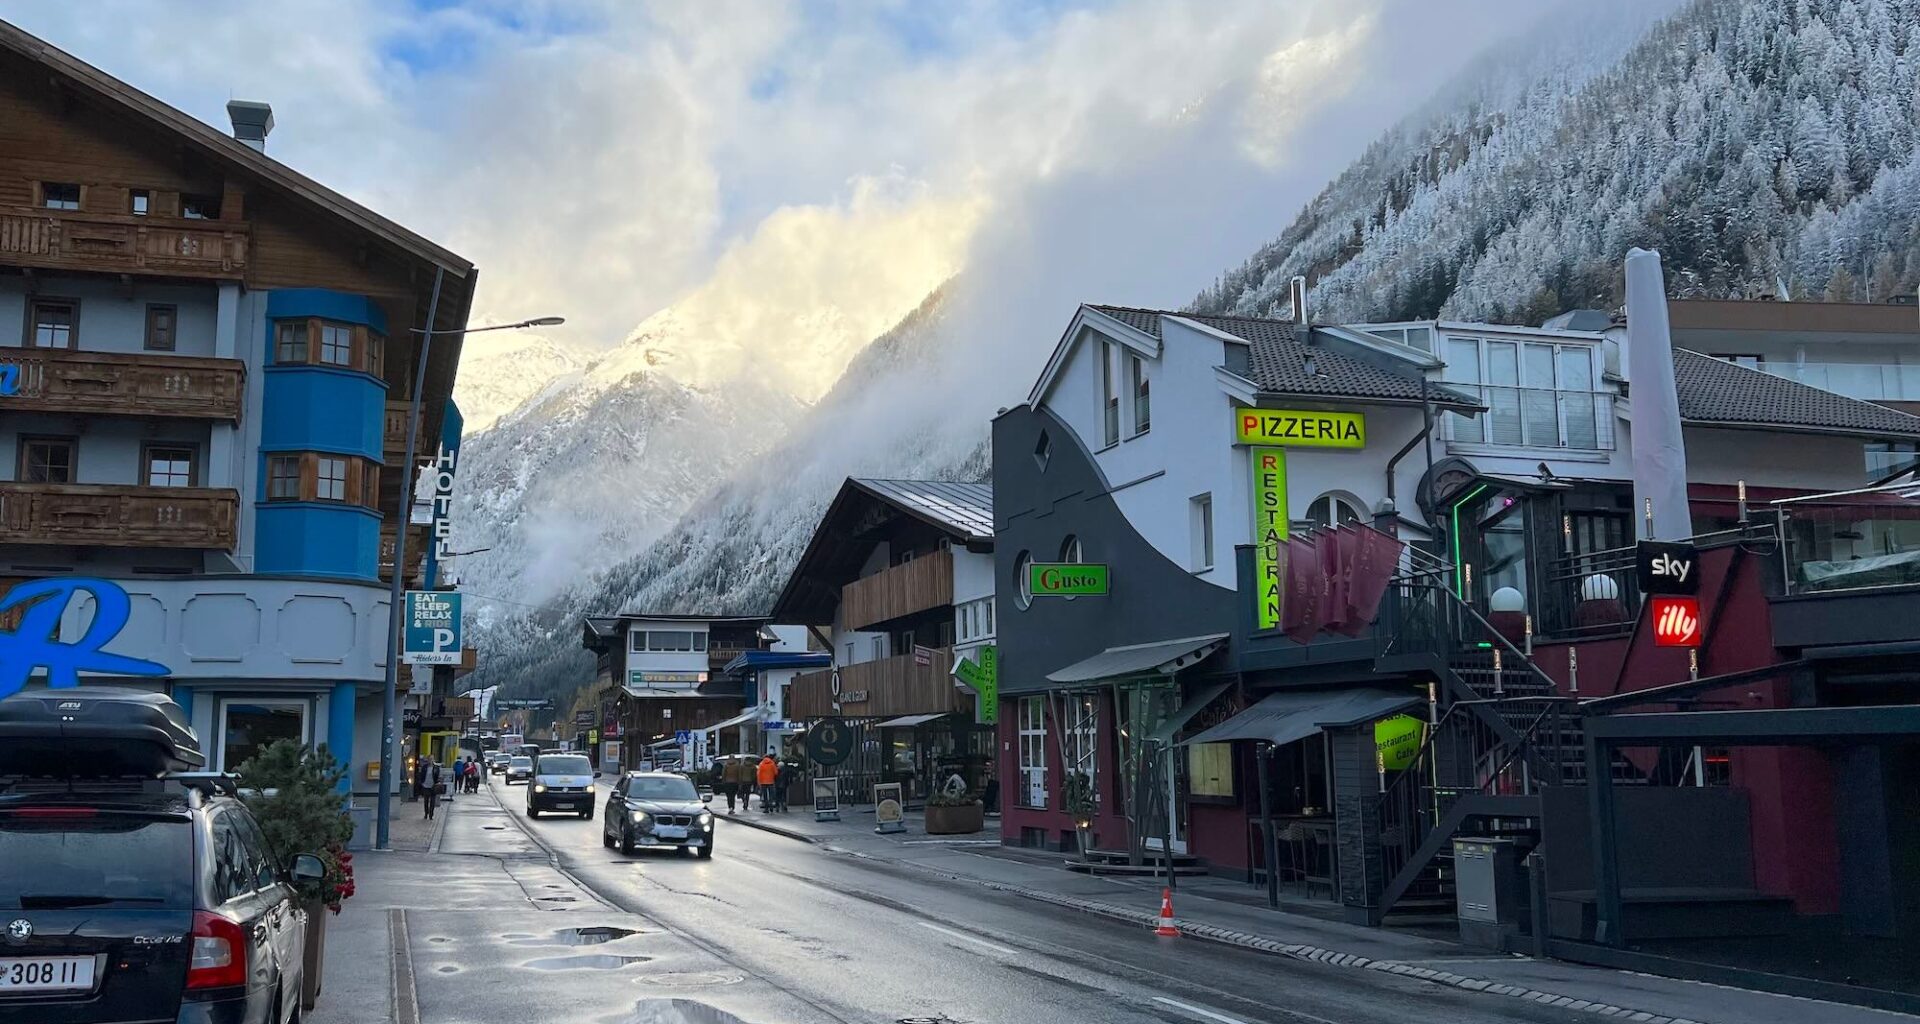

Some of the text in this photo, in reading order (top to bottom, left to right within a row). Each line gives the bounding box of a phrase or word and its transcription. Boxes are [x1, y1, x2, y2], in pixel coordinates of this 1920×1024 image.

[1243, 416, 1361, 440] PIZZERIA
[435, 449, 455, 560] HOTEL
[1651, 553, 1691, 582] sky
[1041, 569, 1097, 590] Gusto
[414, 602, 451, 611] SLEEP
[415, 594, 438, 602] EAT
[414, 611, 452, 619] RELAX
[414, 620, 451, 628] & RIDE
[1658, 605, 1697, 642] illy
[433, 628, 455, 654] P
[414, 654, 441, 662] Riders
[985, 685, 993, 721] PIZZA
[403, 712, 420, 724] sky
[1377, 728, 1416, 751] estaurant
[11, 962, 53, 985] 308
